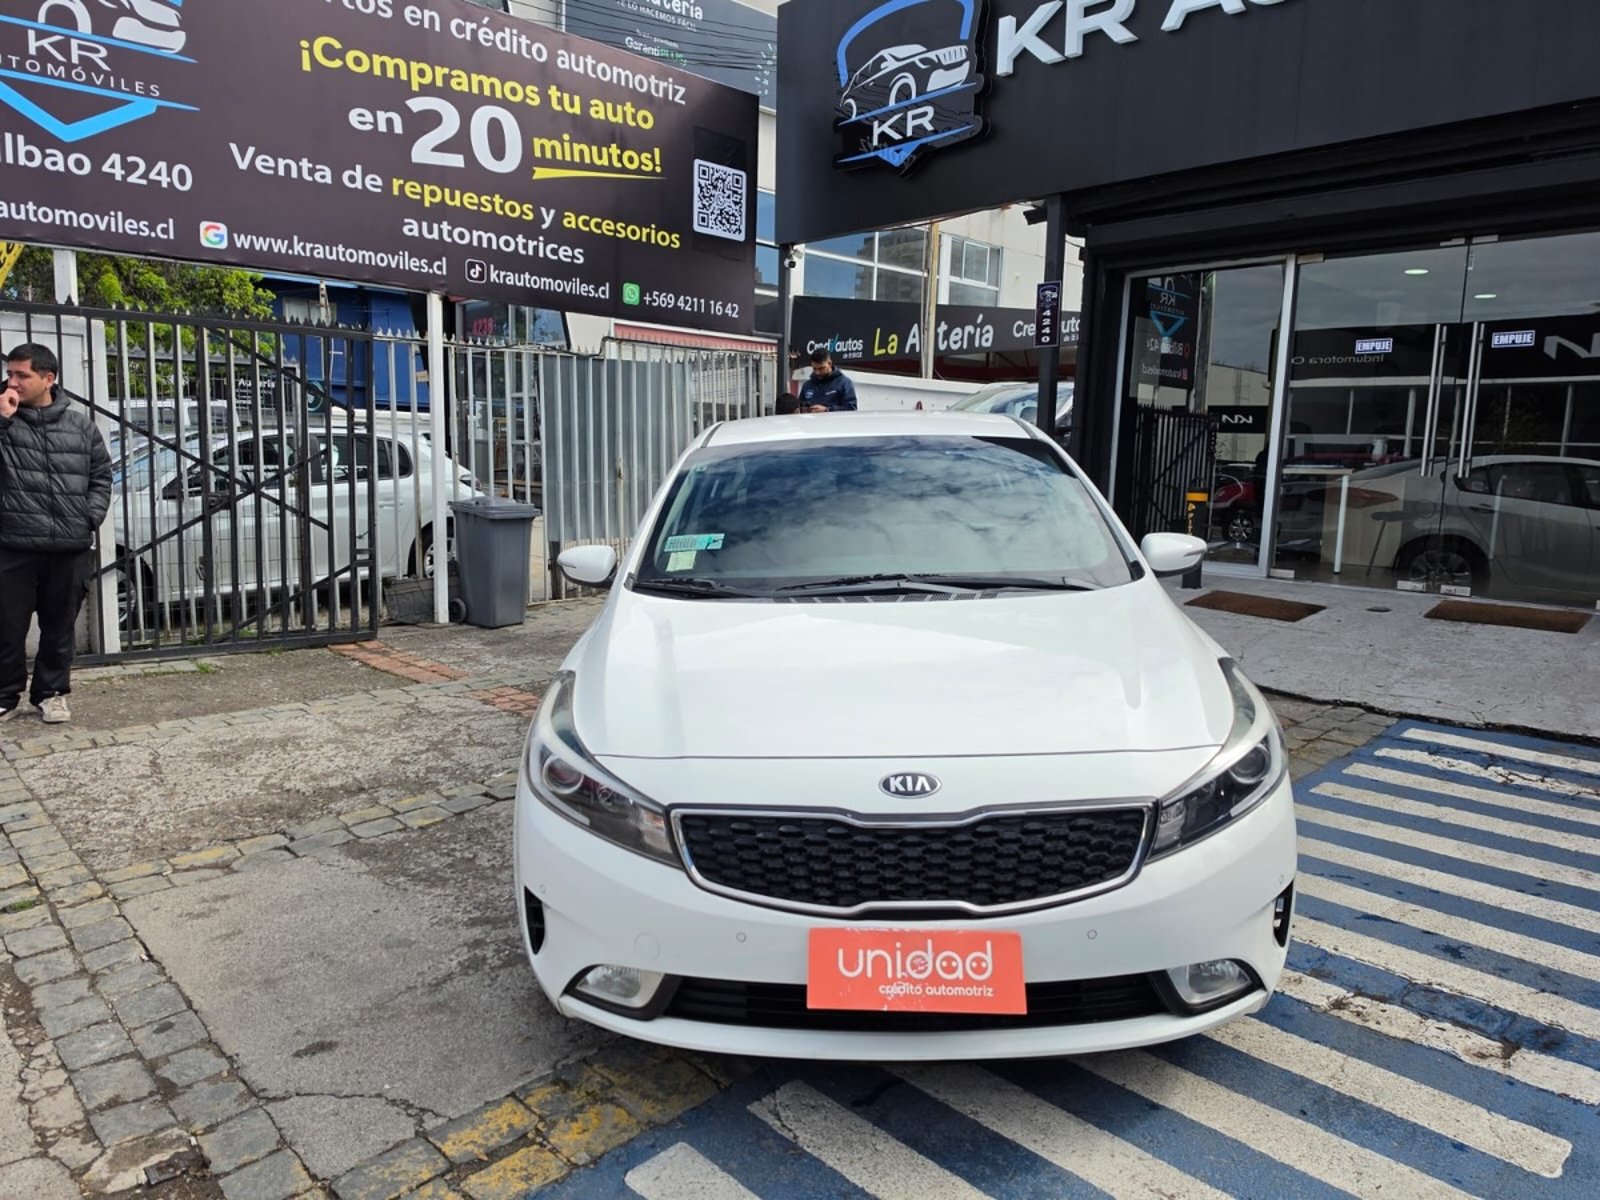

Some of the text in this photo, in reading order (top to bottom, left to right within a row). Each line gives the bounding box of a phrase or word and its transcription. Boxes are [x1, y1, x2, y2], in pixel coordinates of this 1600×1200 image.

[639, 5, 676, 24] HACEMOS
[28, 29, 111, 71] KR
[404, 5, 440, 32] en
[450, 17, 548, 63] crédito
[557, 50, 687, 105] automotriz
[996, 0, 1139, 76] KR
[0, 54, 160, 96] TOMÓVILES
[300, 36, 654, 129] ¡Compramos tu auto
[348, 96, 662, 173] en 20 minutos!
[872, 105, 935, 147] KR
[0, 132, 193, 191] lbao 4240
[229, 142, 681, 249] Venta de repuestos y accesorios
[233, 232, 447, 276] www.krautomoviles.cl
[402, 218, 585, 265] automotrices
[489, 264, 610, 300] krautomoviles.cl
[643, 290, 739, 318] +569 4211 16 42
[874, 313, 994, 356] La Atería
[1041, 309, 1052, 343] 4240
[1358, 341, 1390, 351] EMPUJE
[1494, 333, 1533, 345] EMPUJE
[890, 775, 931, 792] KIA
[838, 939, 993, 981] unidad
[925, 985, 994, 997] automotriz
